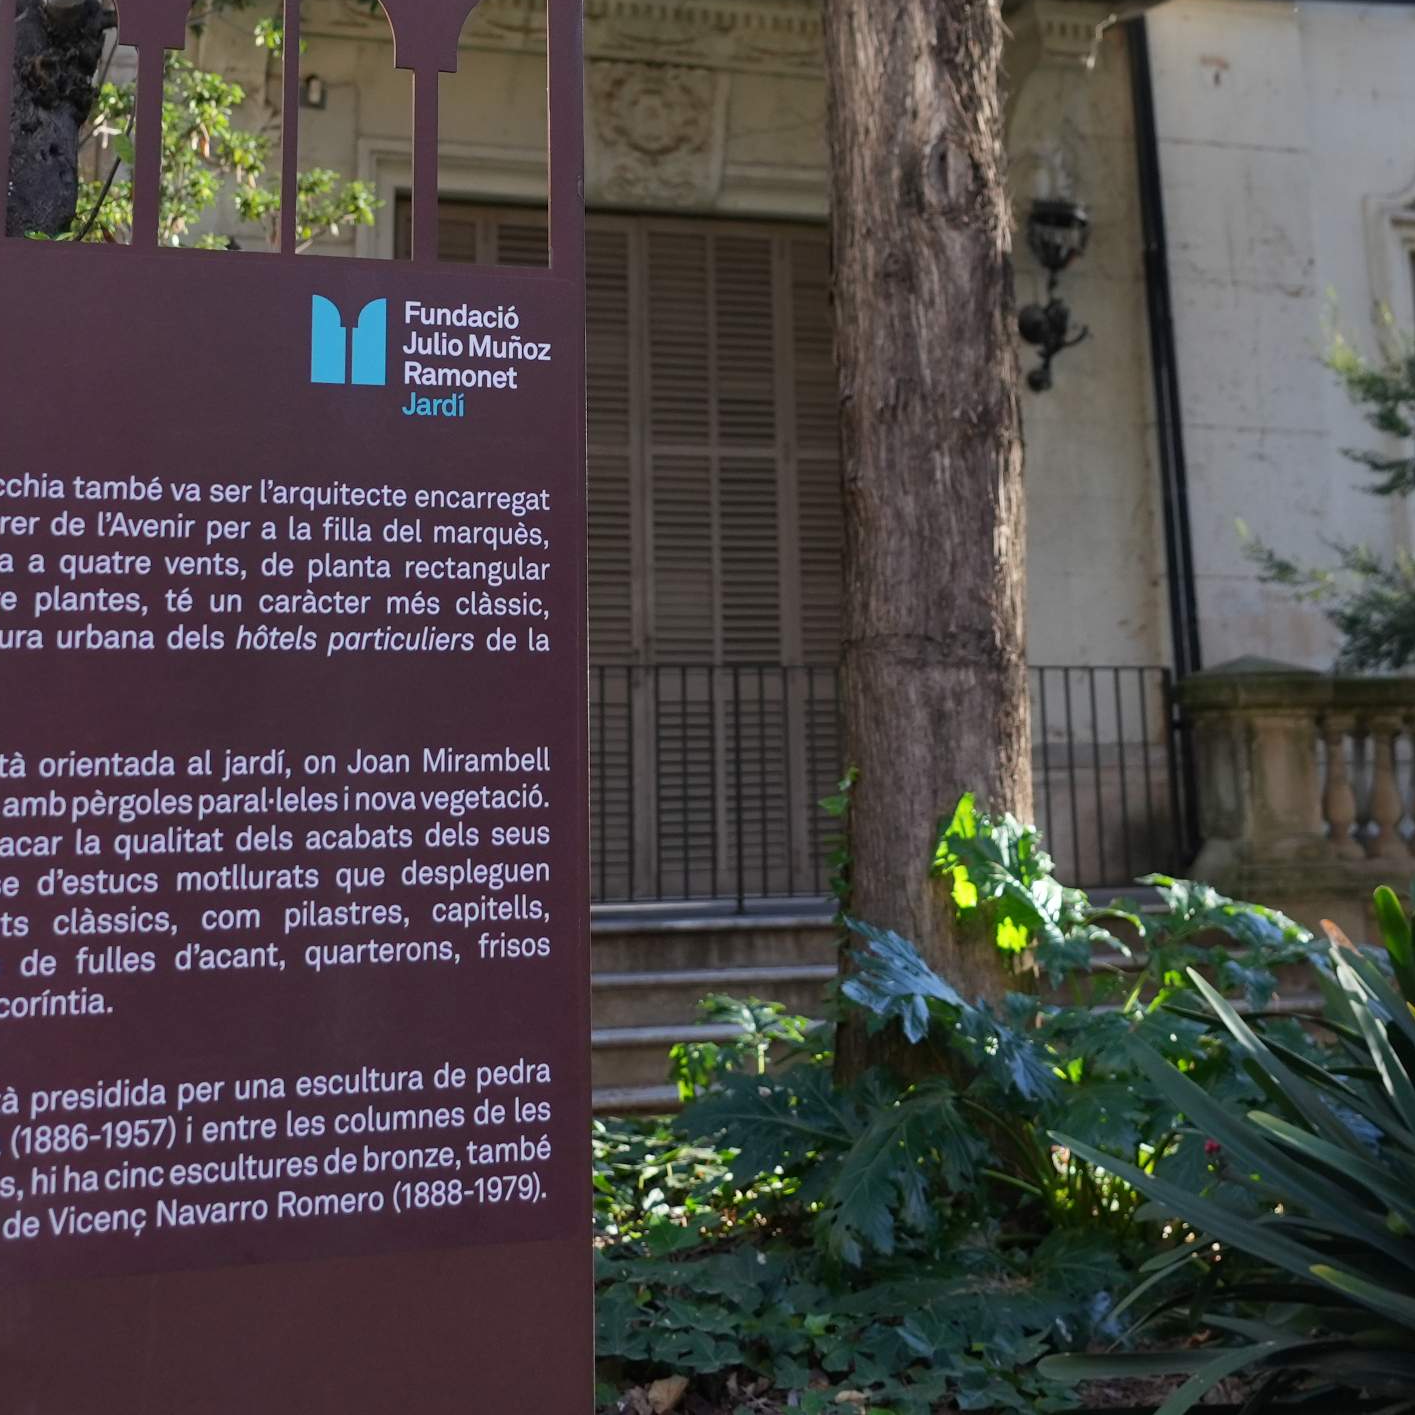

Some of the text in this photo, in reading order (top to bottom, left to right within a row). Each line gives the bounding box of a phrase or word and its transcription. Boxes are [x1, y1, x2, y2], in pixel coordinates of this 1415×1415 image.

[404, 300, 520, 330] Fundació
[402, 330, 552, 361] Julio Muñoz
[404, 360, 518, 390] Ramonet
[401, 391, 465, 417] Jardí
[72, 475, 163, 501] també
[170, 482, 202, 502] va
[209, 483, 253, 503] ser
[260, 478, 408, 512] l’arquitecte
[414, 489, 551, 517] encarregat
[50, 510, 86, 537] de
[97, 511, 196, 538] l’Avenir
[206, 519, 252, 546] per
[260, 521, 277, 540] a
[288, 515, 313, 541] la
[322, 516, 373, 543] filla
[382, 517, 423, 543] del
[433, 521, 549, 551] marquès,
[27, 553, 46, 574] a
[59, 551, 152, 581] quatre
[164, 552, 247, 581] vents,
[261, 551, 294, 577] de
[307, 552, 392, 584] planta
[405, 556, 551, 587] rectangular
[34, 585, 148, 618] plantes,
[164, 587, 193, 613] té
[209, 593, 242, 613] un
[258, 588, 372, 615] caràcter
[386, 590, 441, 615] més
[455, 590, 549, 621] clàssic,
[56, 623, 155, 650] urbana
[166, 623, 225, 650] dels
[235, 624, 318, 651] hôtels
[326, 625, 475, 657] particuliers
[486, 626, 517, 652] de
[528, 626, 550, 652] la
[38, 749, 176, 778] orientada
[187, 749, 213, 776] al
[221, 748, 291, 782] jardí,
[303, 754, 336, 775] on
[346, 748, 410, 774] Joan
[423, 746, 551, 773] Mirambell
[2, 789, 67, 818] amb
[71, 788, 193, 823] pèrgoles
[198, 786, 339, 821] paral·leles
[343, 785, 350, 811] i
[355, 791, 417, 811] nova
[420, 783, 550, 817] vegetació.
[75, 828, 102, 856] la
[113, 826, 224, 861] qualitat
[235, 824, 294, 852] dels
[305, 822, 413, 851] acabats
[424, 820, 480, 848] dels
[491, 825, 551, 846] seus
[37, 868, 159, 896] d’estucs
[176, 863, 320, 892] motllurats
[335, 866, 386, 894] que
[401, 858, 550, 891] despleguen
[53, 905, 178, 936] clàssics,
[201, 908, 261, 931] com
[284, 900, 410, 935] pilastres,
[432, 893, 550, 928] capitells,
[20, 948, 57, 977] de
[75, 945, 156, 975] fulles
[174, 942, 286, 971] d’acant,
[304, 939, 461, 972] quarterons,
[477, 931, 551, 959] frisos
[30, 1077, 167, 1120] presidida
[177, 1081, 225, 1111] per
[234, 1077, 286, 1101] una
[295, 1066, 424, 1097] escultura
[433, 1061, 467, 1089] de
[476, 1057, 552, 1094] pedra
[10, 1115, 177, 1159] (1886-1957)
[186, 1115, 193, 1144] i
[202, 1115, 277, 1143] entre
[286, 1109, 326, 1137] les
[334, 1105, 465, 1135] columnes
[473, 1098, 506, 1126] de
[514, 1096, 551, 1123] les
[31, 1165, 57, 1196] hi
[63, 1164, 99, 1193] ha
[104, 1160, 164, 1191] cinc
[169, 1153, 319, 1186] escultures
[323, 1146, 358, 1175] de
[363, 1145, 461, 1173] bronze,
[466, 1133, 552, 1165] també
[2, 1209, 41, 1240] de
[48, 1205, 147, 1237] Vicenç
[156, 1198, 269, 1228] Navarro
[277, 1190, 385, 1218] Romero
[392, 1171, 547, 1214] (1888-1979).
